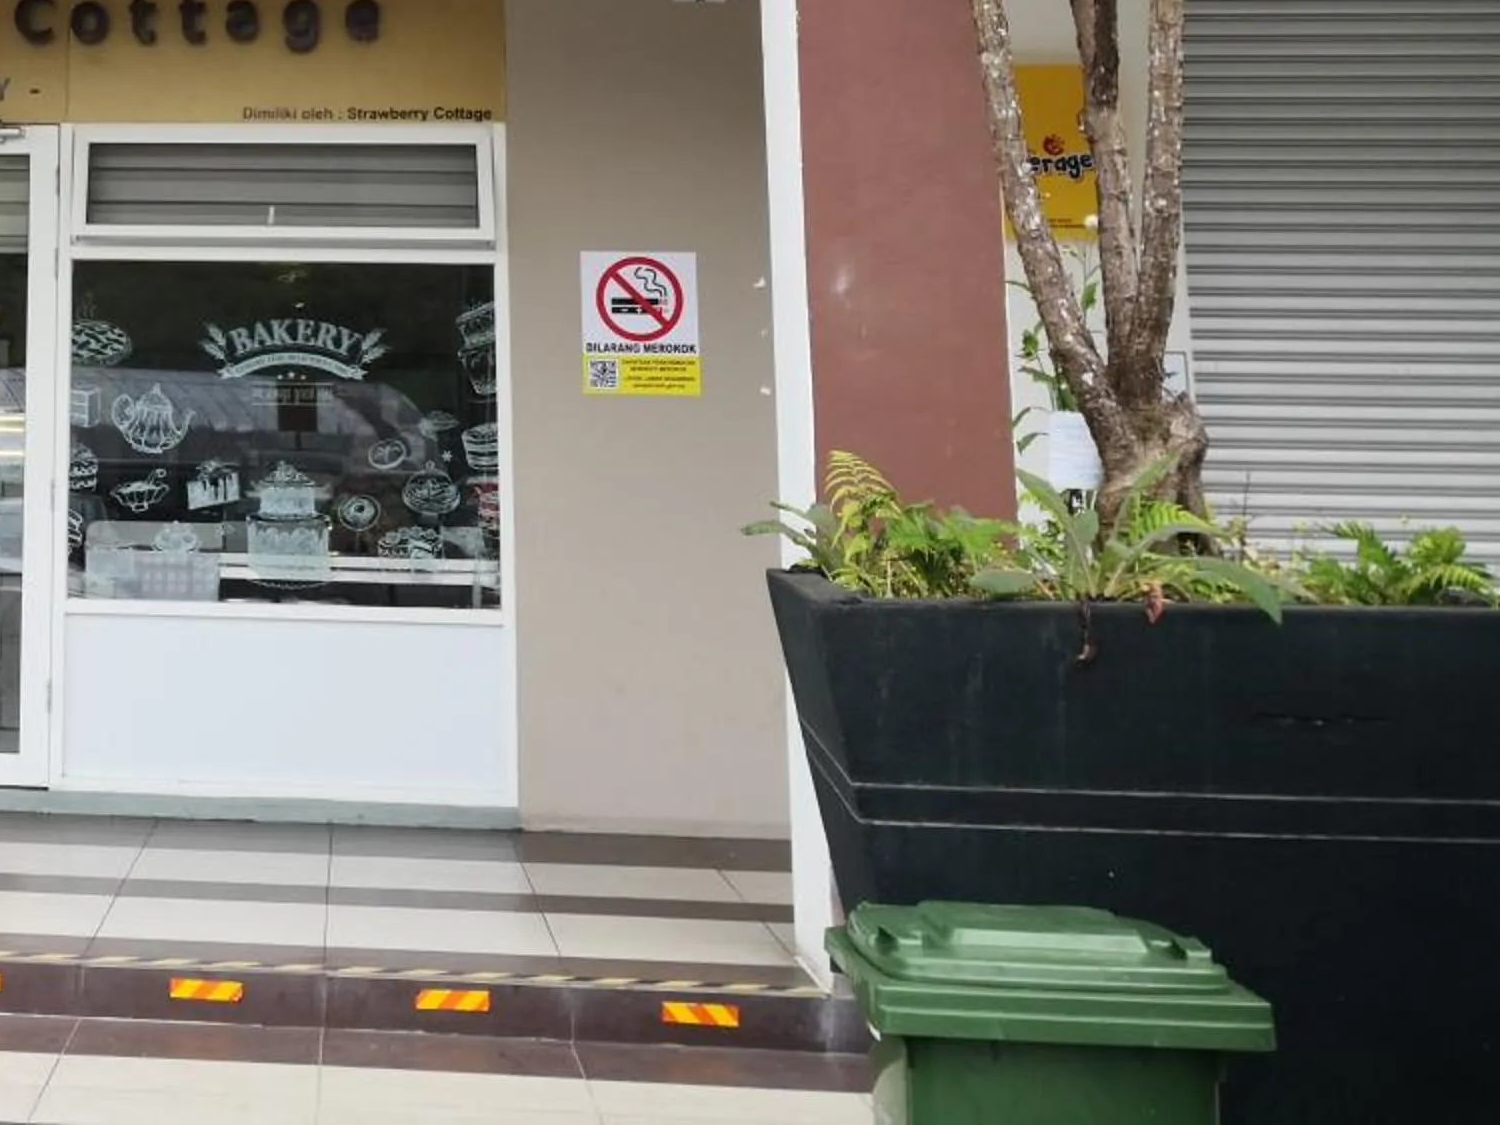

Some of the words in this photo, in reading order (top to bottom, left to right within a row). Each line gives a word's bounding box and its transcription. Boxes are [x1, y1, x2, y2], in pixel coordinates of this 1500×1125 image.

[243, 107, 297, 121] Dimiliki
[302, 107, 333, 121] oleh
[347, 107, 428, 122] Strawberry
[433, 106, 492, 122] Cottage
[227, 318, 363, 357] BAKERY
[586, 342, 640, 353] DILARANG
[643, 343, 697, 354] MEROKOK
